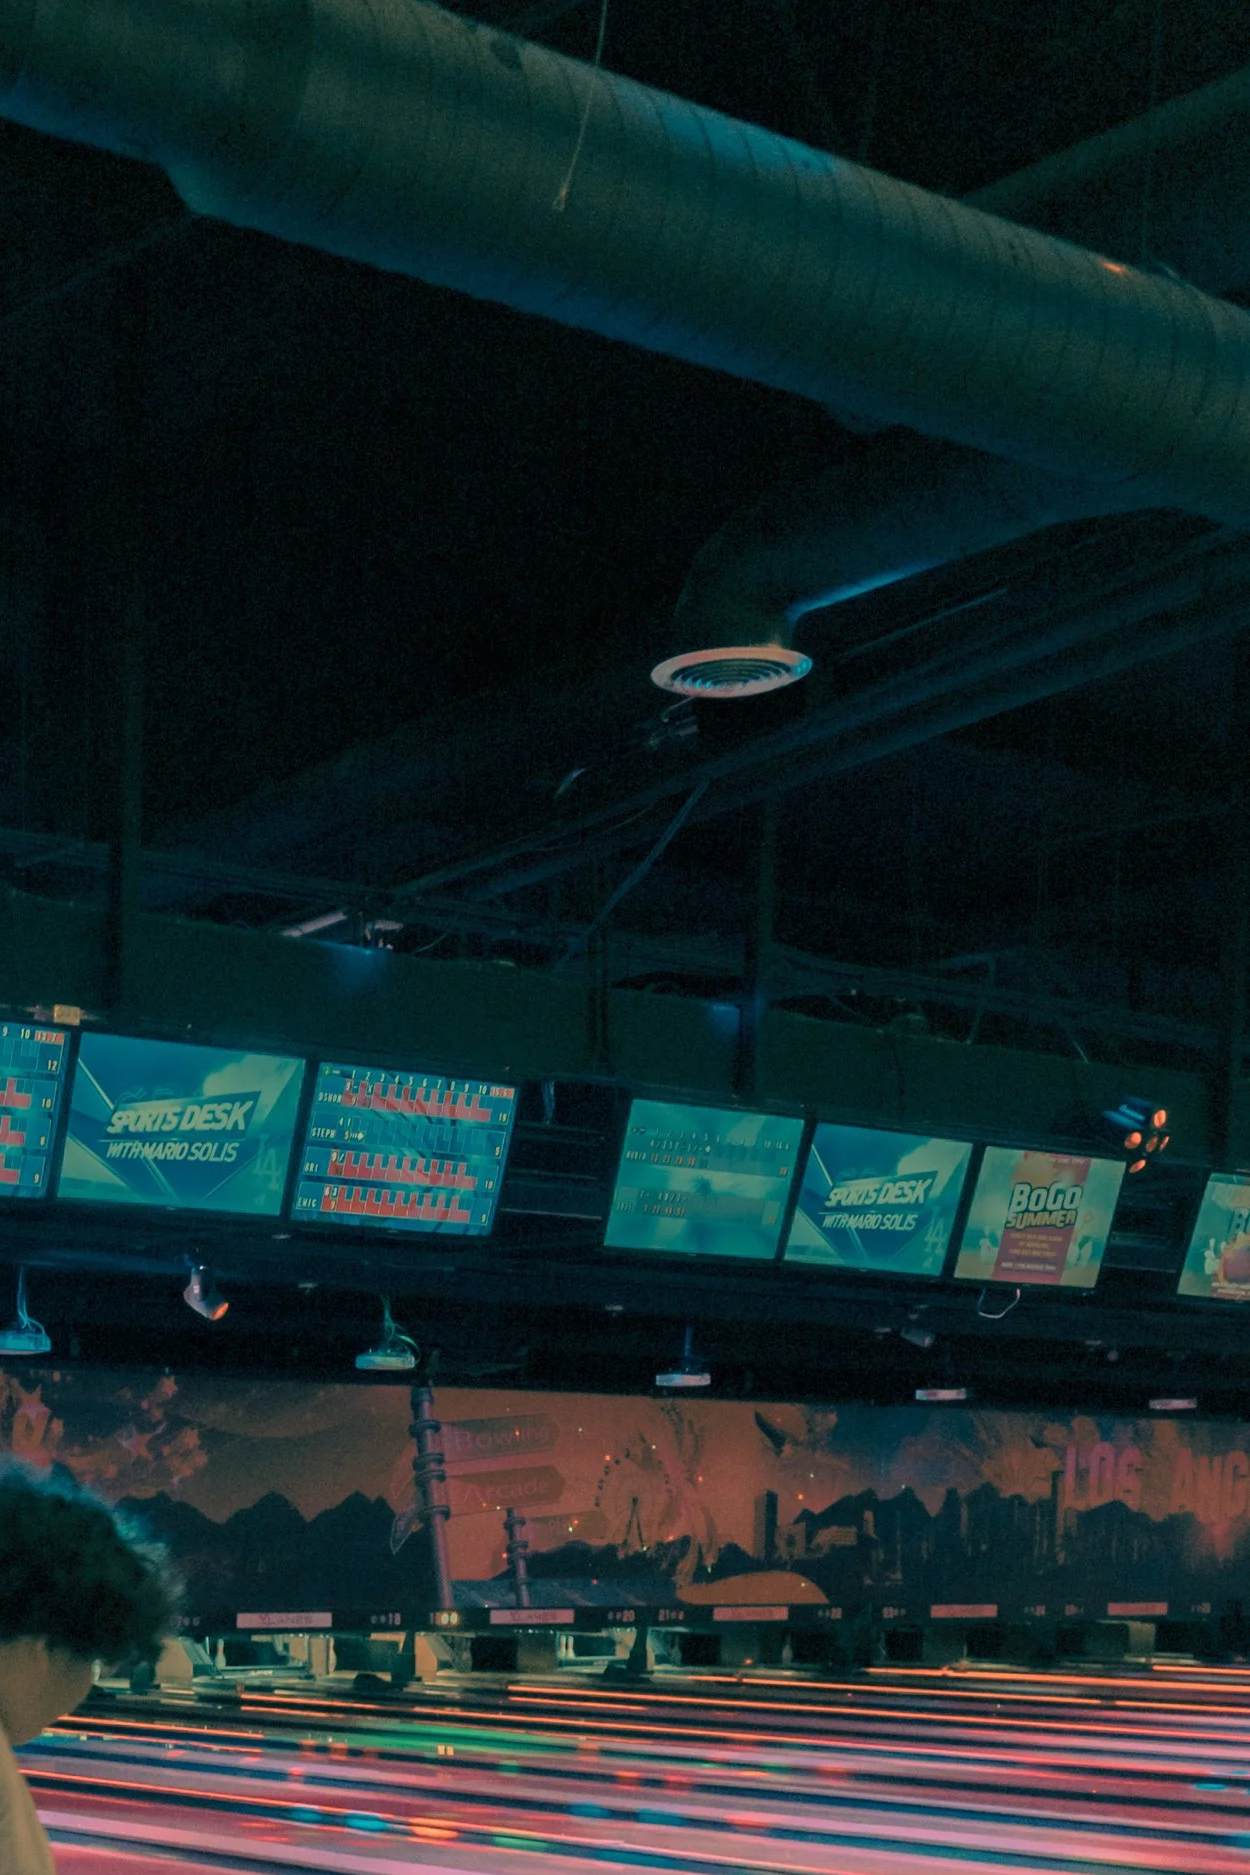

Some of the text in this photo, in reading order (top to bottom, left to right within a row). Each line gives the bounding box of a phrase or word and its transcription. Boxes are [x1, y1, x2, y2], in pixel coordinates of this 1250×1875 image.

[47, 1060, 57, 1071] 12
[41, 1098, 51, 1109] 10
[106, 1101, 254, 1134] SPORTS DESK
[106, 1141, 240, 1163] WITH MARIO SOLIS
[825, 1178, 933, 1207] SPORTS DESK
[1010, 1182, 1083, 1212] BOGO
[847, 1214, 882, 1230] MARIO
[879, 1214, 918, 1231] SOLIS
[1005, 1210, 1078, 1230] SUMMER
